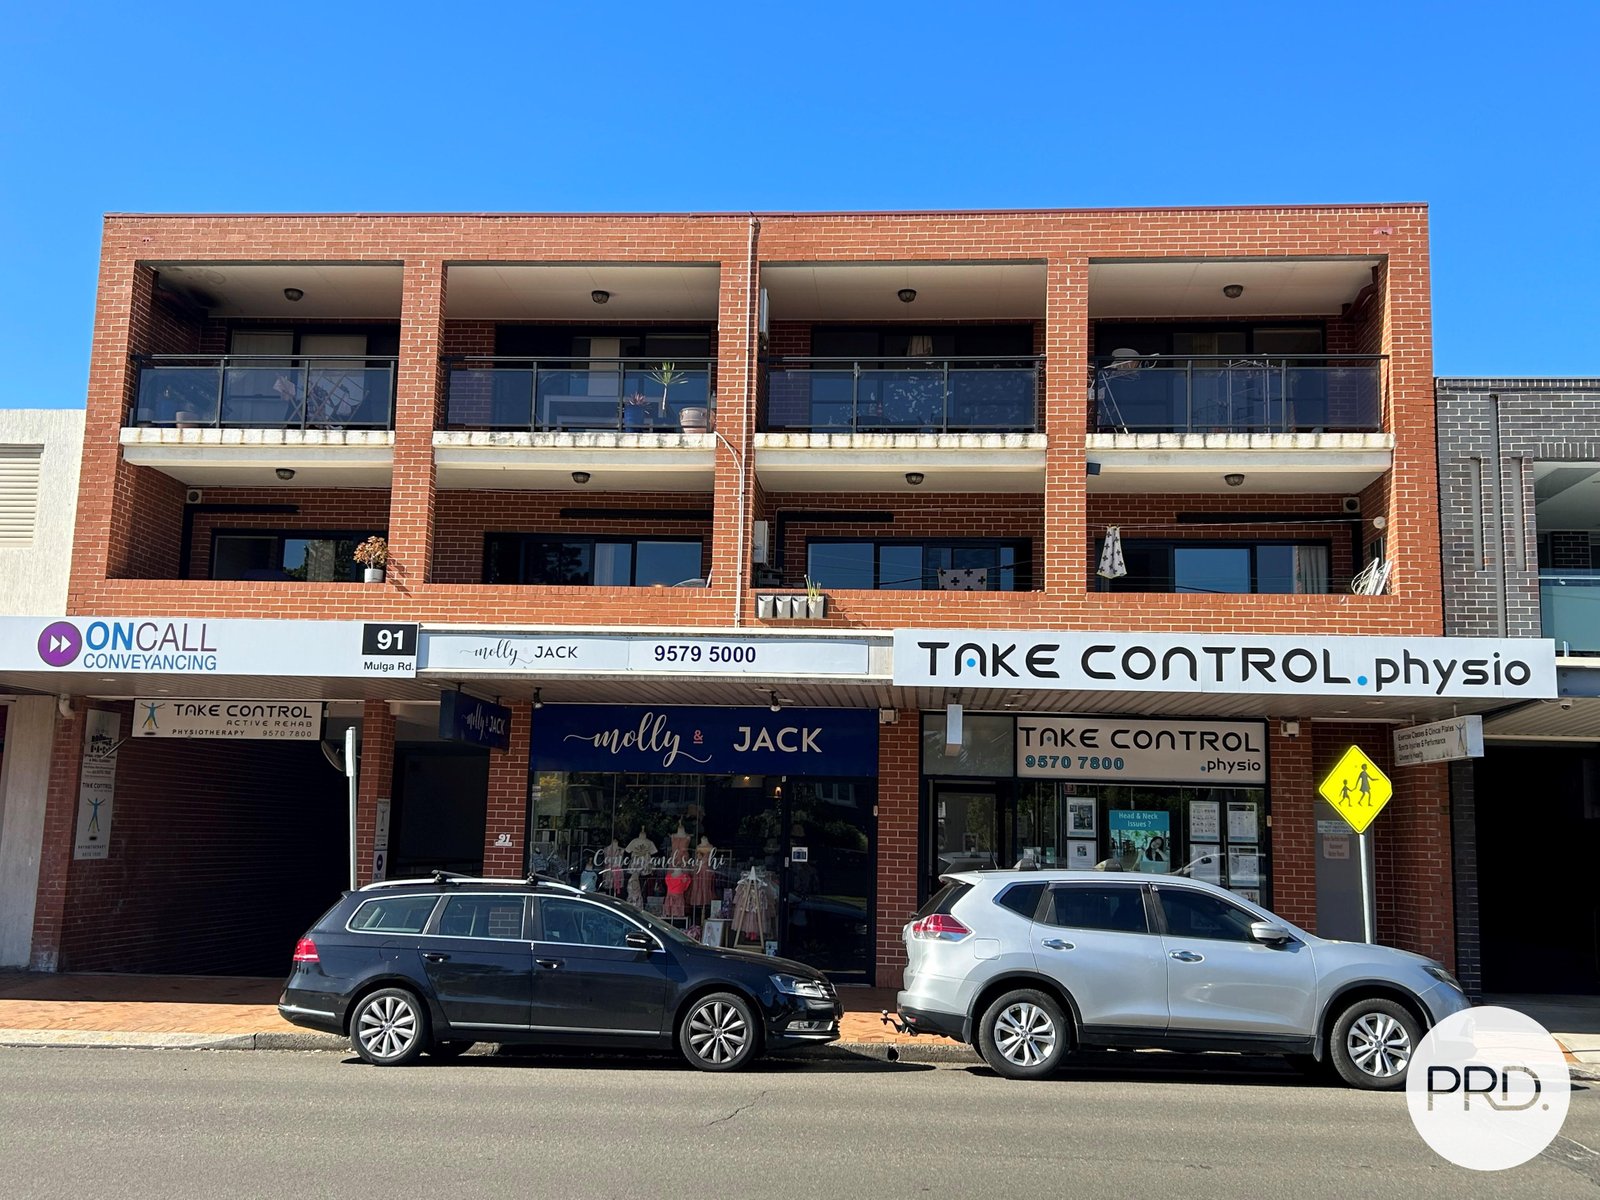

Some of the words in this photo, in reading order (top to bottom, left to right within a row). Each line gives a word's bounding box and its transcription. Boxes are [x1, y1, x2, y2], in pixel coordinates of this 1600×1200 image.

[86, 620, 217, 652] ONCALL
[377, 629, 404, 650] 91
[459, 638, 533, 666] molly
[534, 645, 578, 659] JACK
[654, 645, 701, 662] 9579
[709, 646, 756, 663] 5000
[917, 641, 1060, 679] TAKE
[83, 653, 217, 671] CONVEYANCING
[363, 661, 395, 672] Mulga
[397, 661, 415, 671] Rd.
[173, 703, 221, 717] TAKE
[226, 704, 312, 719] CONTROL
[172, 728, 245, 736] PHYSIOTHERAPY
[226, 719, 269, 727] ACTIVE
[275, 720, 313, 728] REHAB
[488, 715, 506, 736] JACK
[289, 730, 312, 738] 7800
[564, 712, 712, 768] molly
[693, 730, 703, 744] &
[733, 726, 822, 753] JACK
[1018, 726, 1100, 749] TAKE
[1110, 729, 1261, 752] CONTROL
[1025, 754, 1072, 769] 9570
[1077, 756, 1125, 771] 7800
[1127, 820, 1146, 828] Issues
[498, 833, 511, 844] 91
[650, 847, 680, 867] and
[681, 856, 704, 874] say
[707, 846, 726, 869] hi
